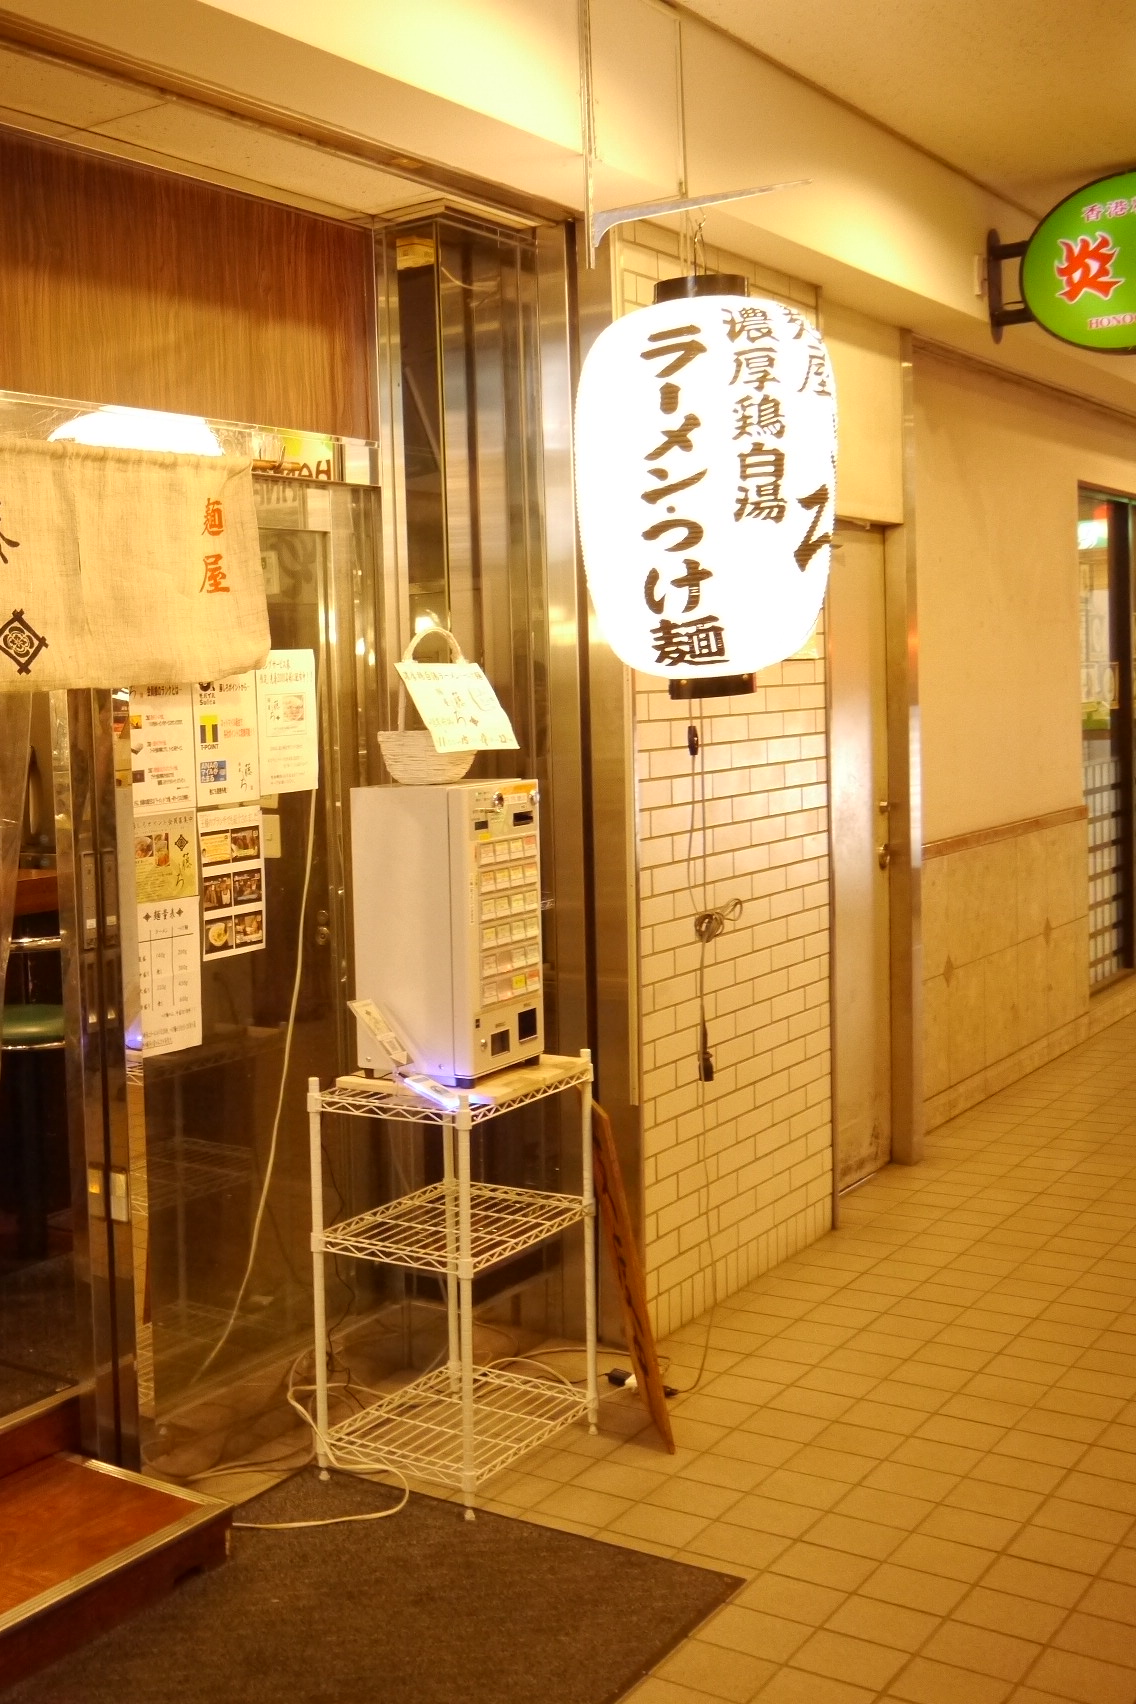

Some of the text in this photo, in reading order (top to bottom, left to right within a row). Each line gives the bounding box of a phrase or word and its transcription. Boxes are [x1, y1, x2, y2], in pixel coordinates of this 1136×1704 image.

[1054, 231, 1126, 305] 炎
[1087, 313, 1136, 330] HONO
[720, 307, 789, 525] 濃厚鶏白湯
[200, 743, 219, 751] T-POINT
